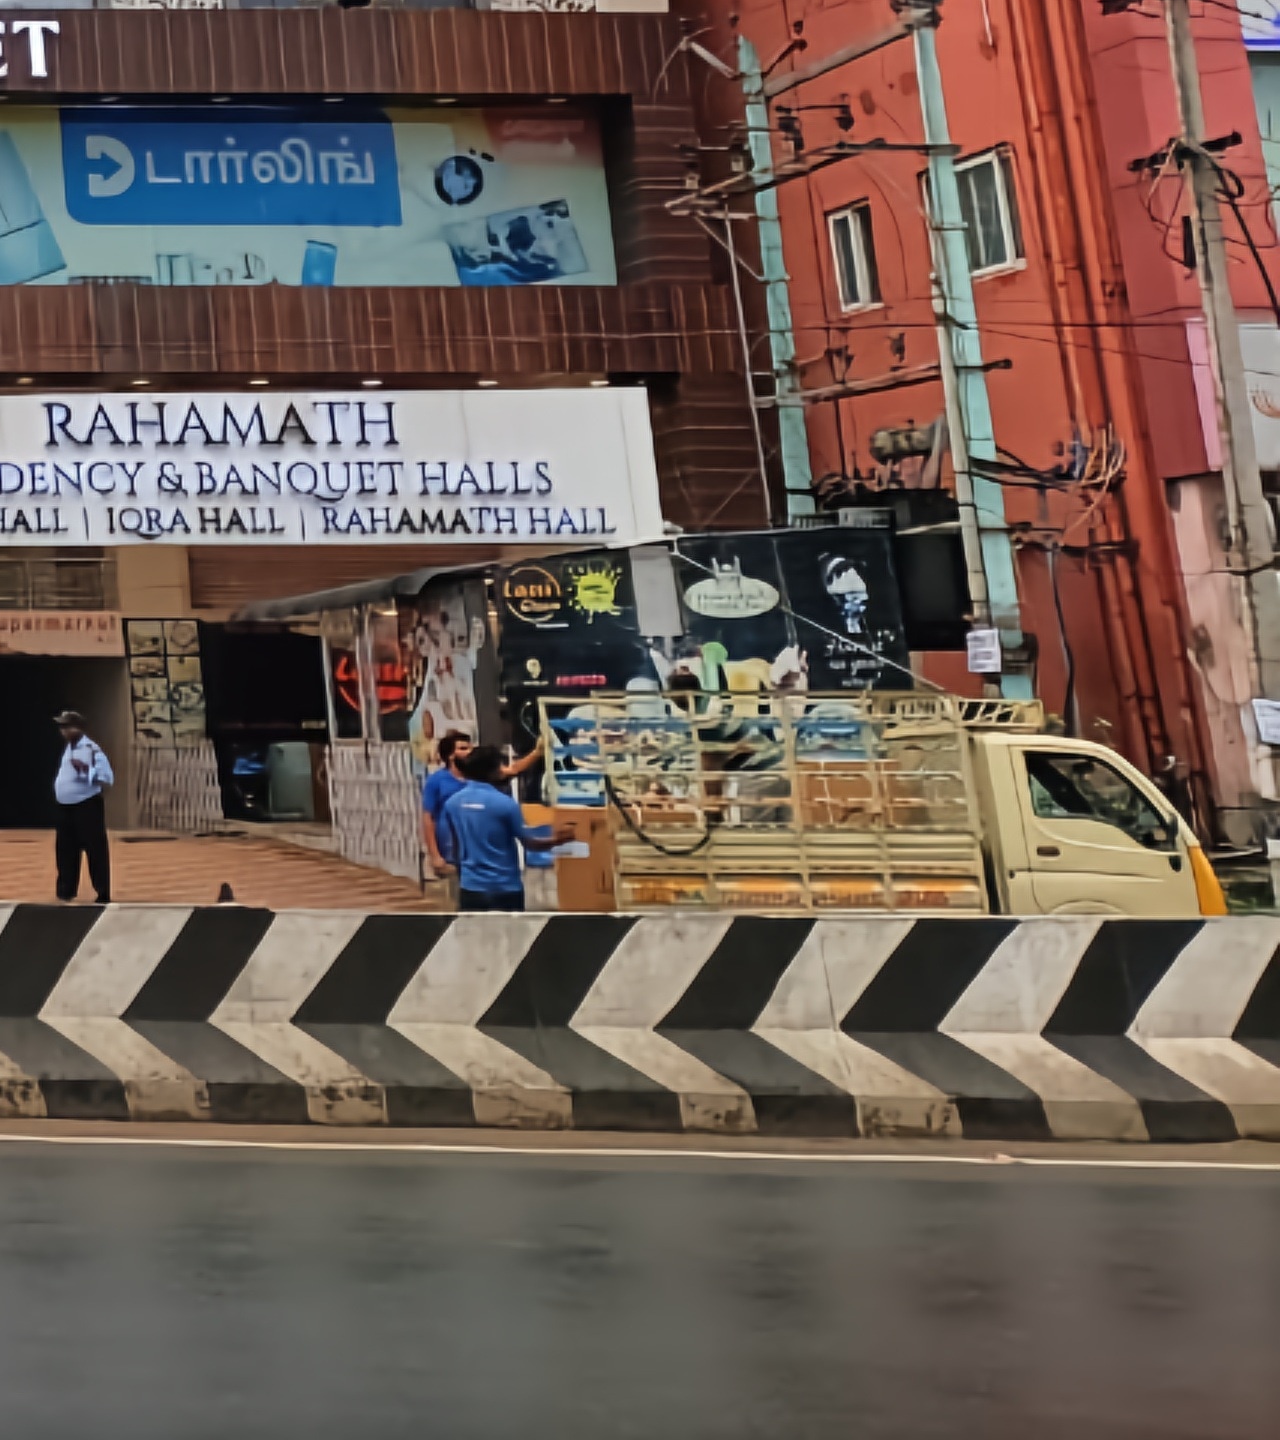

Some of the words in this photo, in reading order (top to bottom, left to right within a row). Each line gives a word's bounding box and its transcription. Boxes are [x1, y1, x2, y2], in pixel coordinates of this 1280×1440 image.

[145, 136, 375, 185] டார்லிங்
[42, 401, 400, 448] RAHAMATH
[157, 462, 189, 498] &
[194, 461, 405, 503] BANQUET
[416, 461, 554, 497] HALLS
[107, 507, 191, 541] IQRA
[197, 507, 286, 536] HALL
[321, 507, 518, 536] RAHAMATH
[527, 507, 618, 535] HALL
